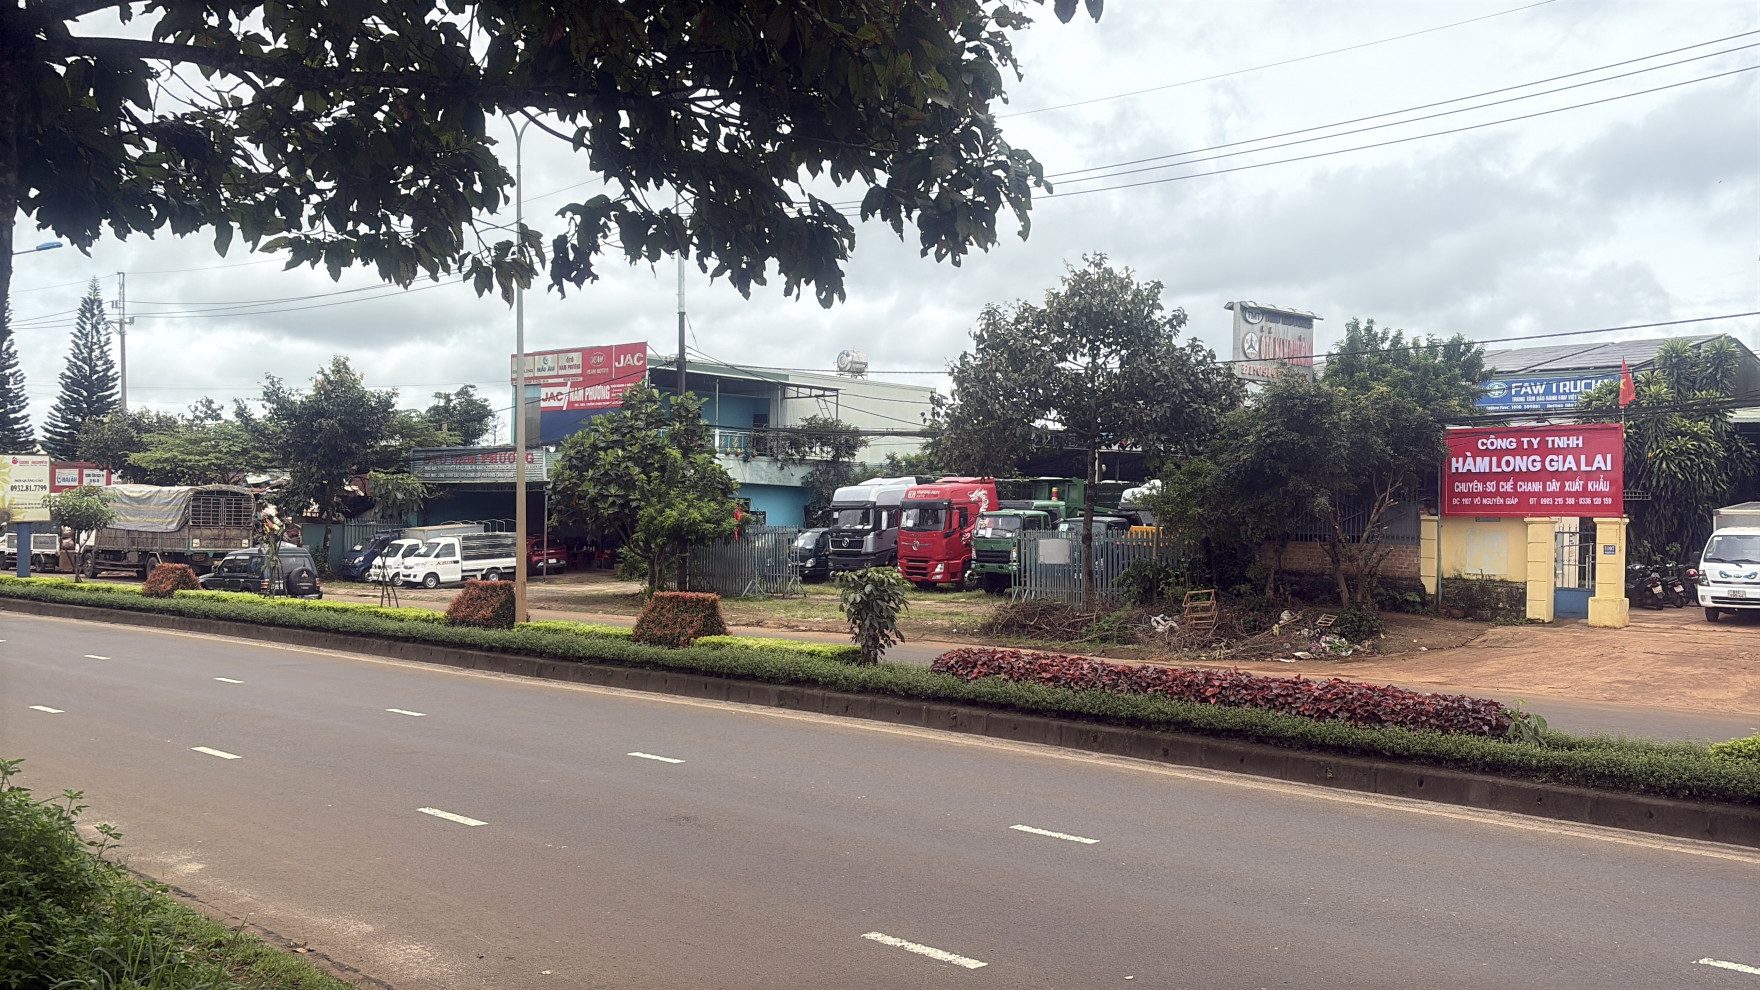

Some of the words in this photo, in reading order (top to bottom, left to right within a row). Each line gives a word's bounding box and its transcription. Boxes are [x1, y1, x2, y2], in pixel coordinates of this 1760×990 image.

[615, 352, 644, 368] JAC
[569, 388, 584, 402] NAM
[584, 384, 610, 401] PHƯƠNG
[1511, 382, 1546, 395] FAW
[1551, 379, 1608, 394] TRUCK
[542, 391, 564, 402] JAC
[1477, 435, 1517, 450] CÔNG
[1521, 437, 1540, 449] TY
[1546, 436, 1583, 448] TNHH
[1451, 452, 1490, 473] HÀM
[1491, 455, 1542, 473] LONG
[1545, 454, 1578, 472] GIA
[1580, 453, 1612, 471] LAI
[10, 484, 47, 492] 0932.81.7799
[1499, 477, 1514, 492] CHẾ
[1517, 481, 1543, 492] CHANH
[1546, 479, 1561, 492] DÂY
[1564, 476, 1584, 492] XUẤT
[1587, 475, 1610, 491] KHẨU
[1482, 496, 1504, 505] NGUYÊN
[1505, 496, 1518, 505] GIÁP
